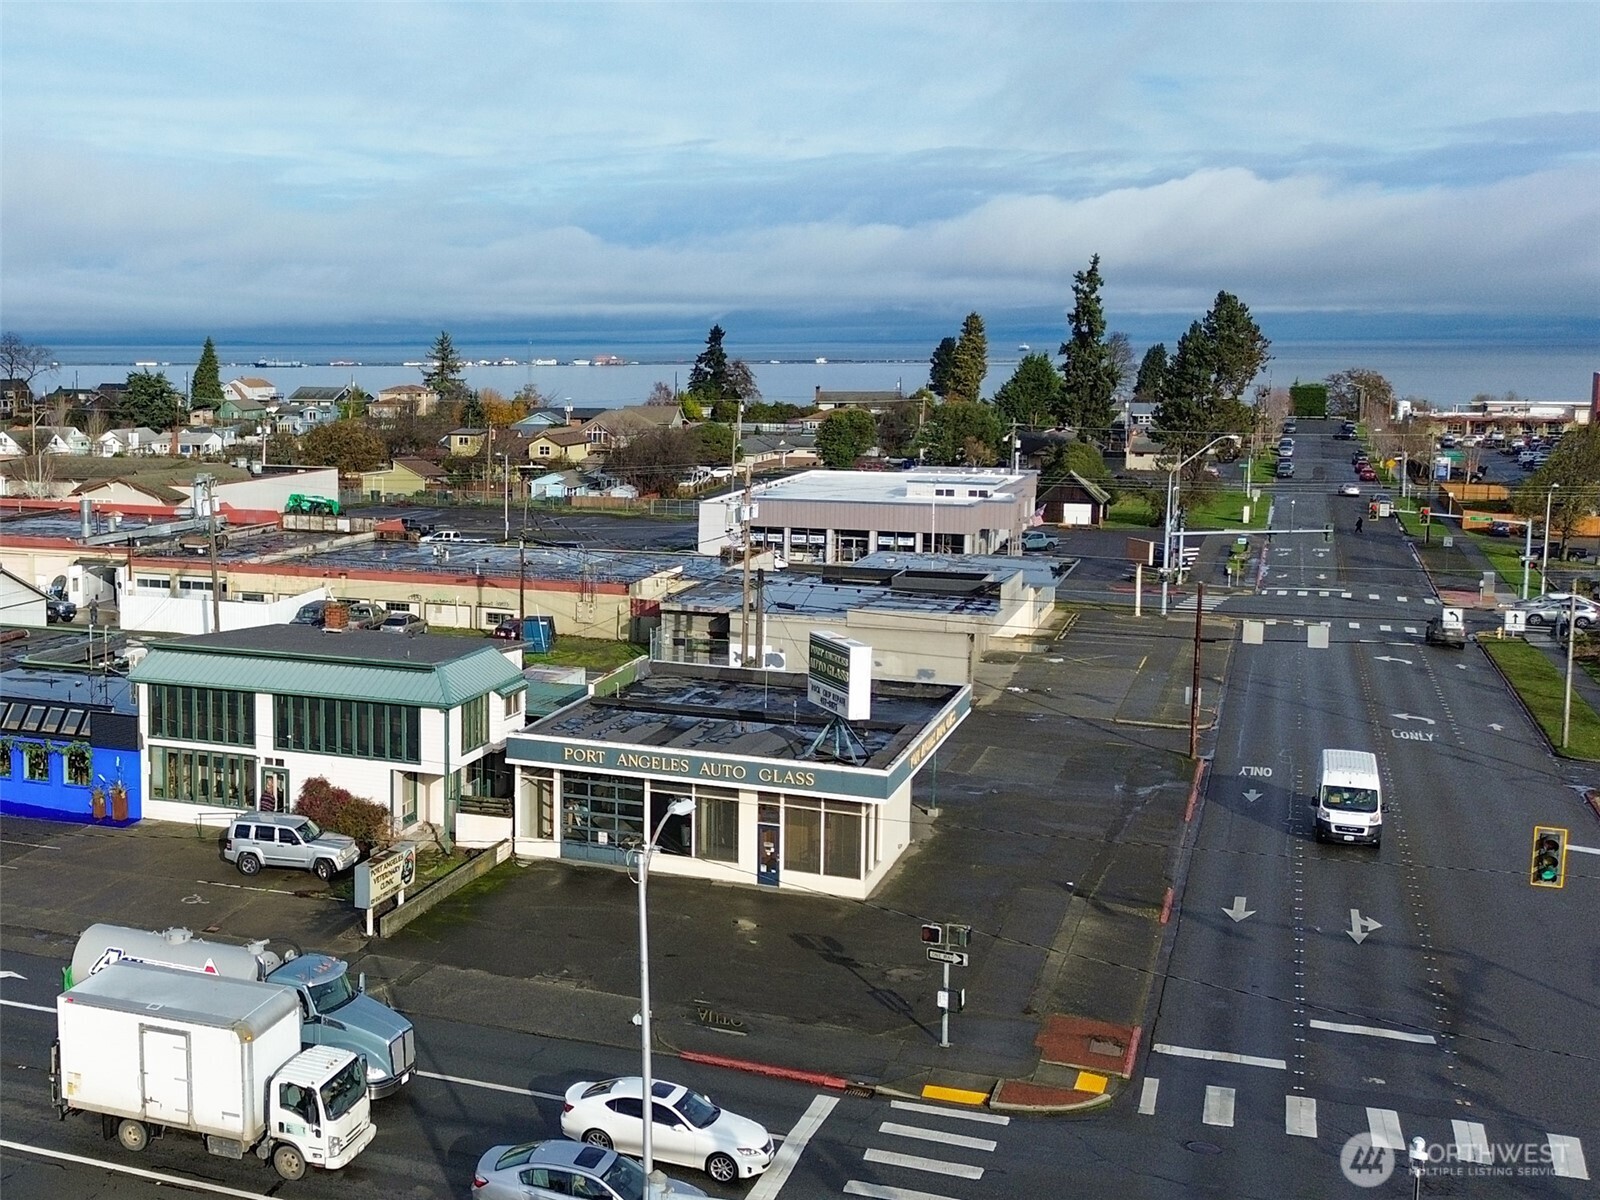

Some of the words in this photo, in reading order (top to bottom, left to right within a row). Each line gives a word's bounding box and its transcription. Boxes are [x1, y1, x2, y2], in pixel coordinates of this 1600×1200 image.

[810, 657, 827, 673] AUTO
[826, 664, 849, 682] GLASS
[564, 747, 606, 764] PORT
[616, 753, 689, 773] ANGELES
[699, 762, 746, 779] AUTO
[758, 768, 815, 786] GLASS
[1238, 766, 1273, 777] ONLY
